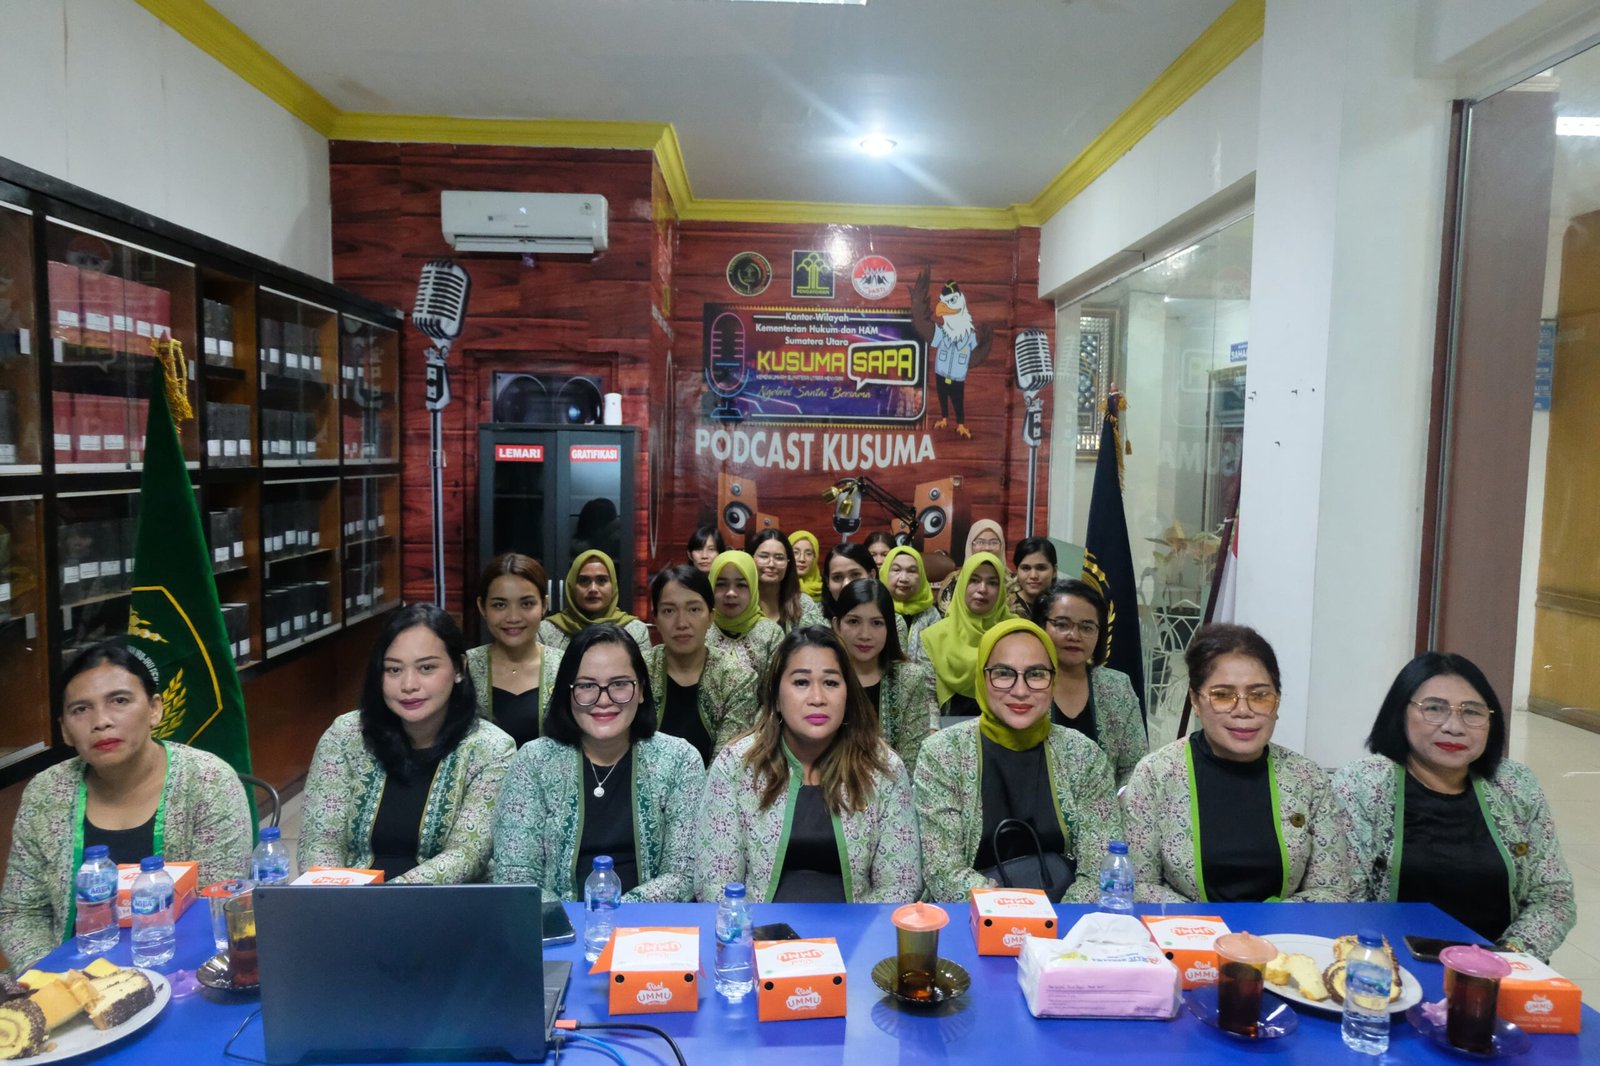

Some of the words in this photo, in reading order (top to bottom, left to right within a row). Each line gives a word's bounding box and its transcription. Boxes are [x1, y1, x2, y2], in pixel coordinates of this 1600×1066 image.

[785, 312, 813, 321] Kantor
[815, 312, 849, 323] Wilayah
[755, 323, 807, 333] Kementerian
[809, 325, 838, 333] Hukum
[840, 325, 856, 334] dan
[858, 325, 879, 335] HAM
[785, 336, 824, 345] Sumatera
[826, 337, 849, 346] Utara
[757, 351, 845, 373] KUSUMA
[853, 348, 912, 378] SAPA
[795, 386, 828, 399] Santai
[830, 387, 871, 399] Bersama
[499, 448, 541, 459] LEMARI
[571, 449, 618, 459] GRATIFIKASI
[695, 429, 814, 470] PODCAST
[823, 433, 935, 471] KUSUMA
[637, 991, 671, 1002] UMMU
[787, 996, 821, 1008] UMMU
